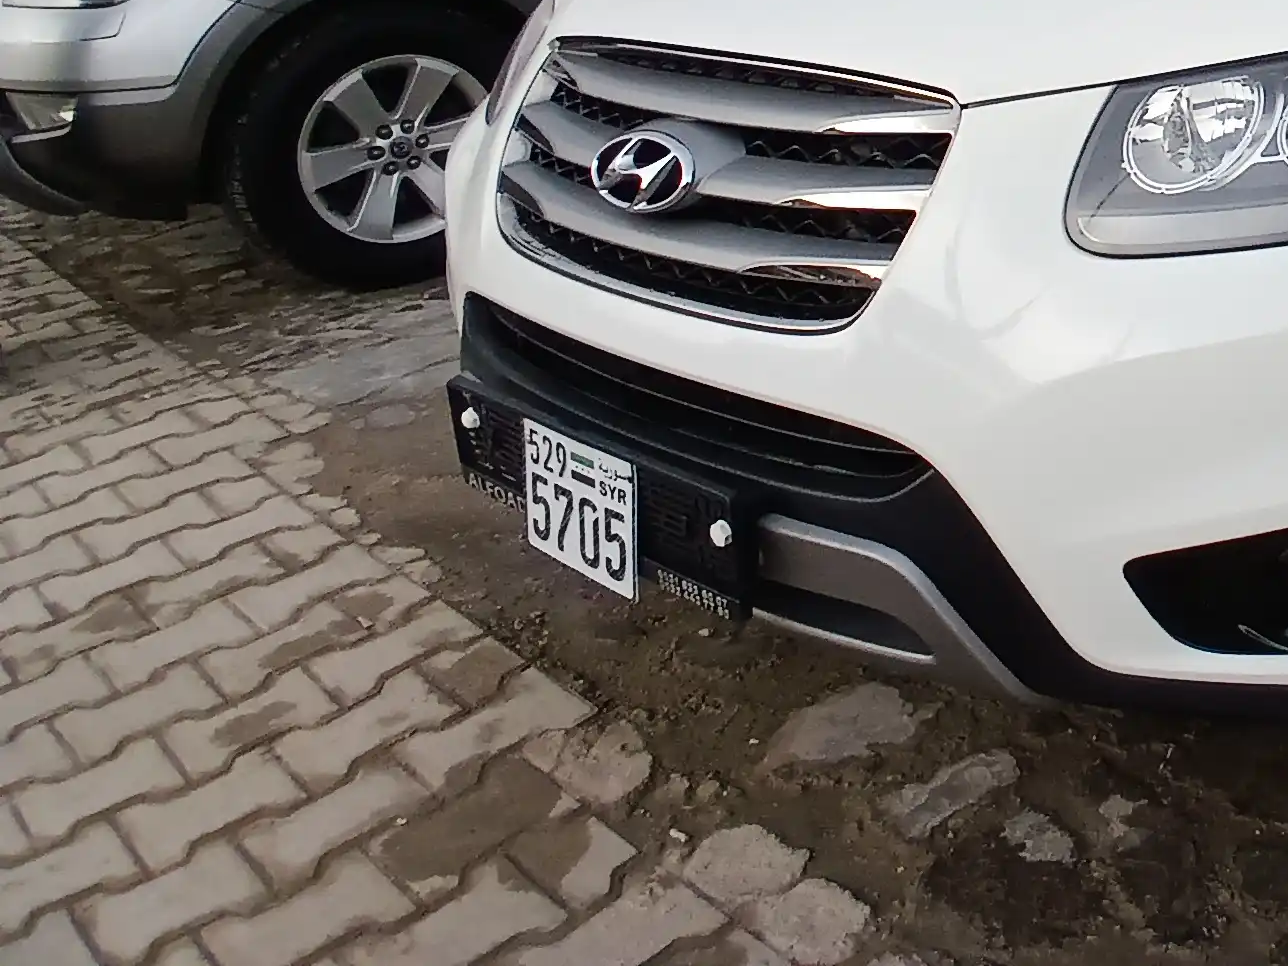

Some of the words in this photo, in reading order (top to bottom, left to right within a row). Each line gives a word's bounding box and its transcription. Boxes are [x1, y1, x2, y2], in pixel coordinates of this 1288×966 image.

[526, 428, 567, 479] 529
[599, 480, 628, 507] SYR
[531, 471, 627, 582] 5705
